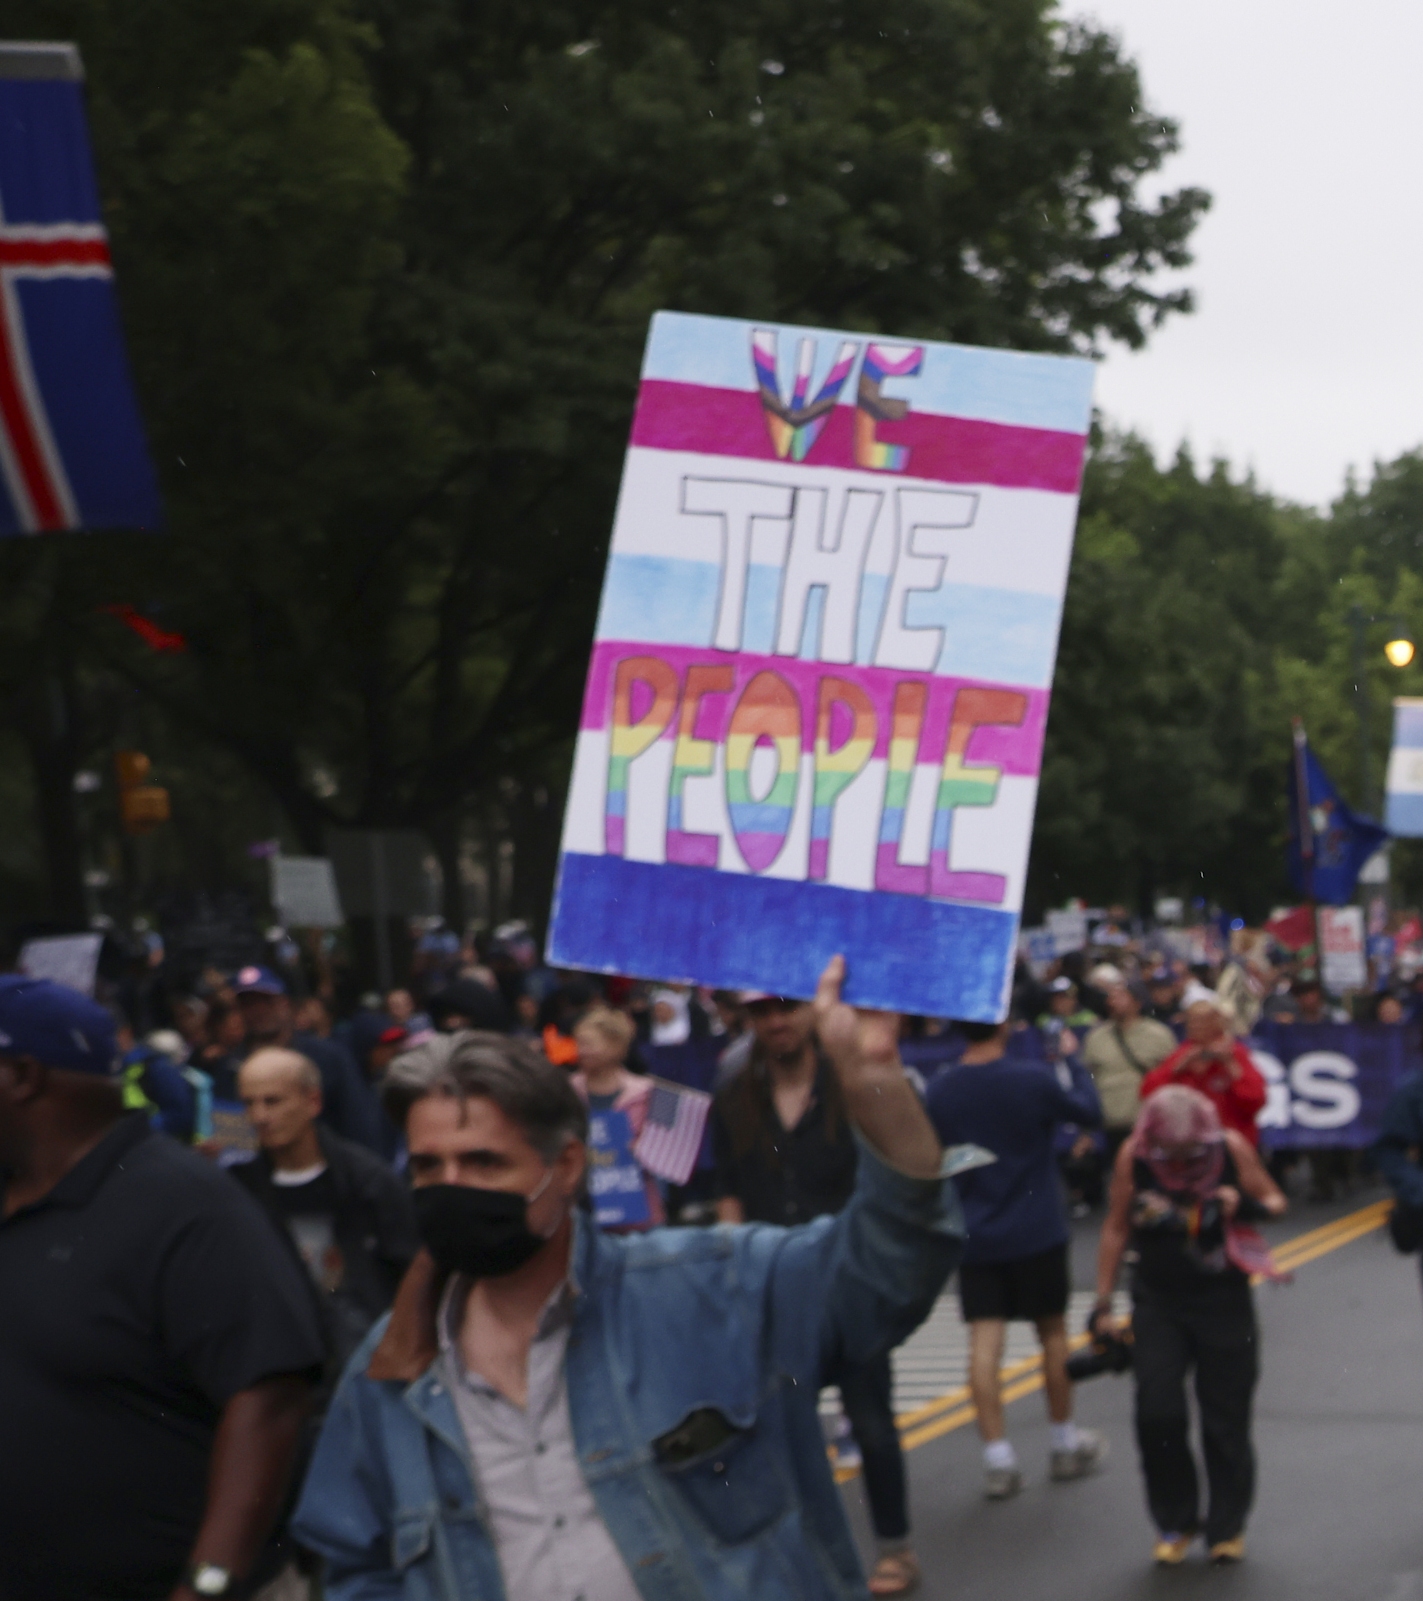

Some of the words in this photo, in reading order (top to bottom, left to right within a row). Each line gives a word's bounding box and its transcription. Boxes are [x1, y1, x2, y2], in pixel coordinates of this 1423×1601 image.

[753, 328, 922, 470] WE
[680, 475, 980, 671] THE
[604, 656, 1028, 904] PEOPLE
